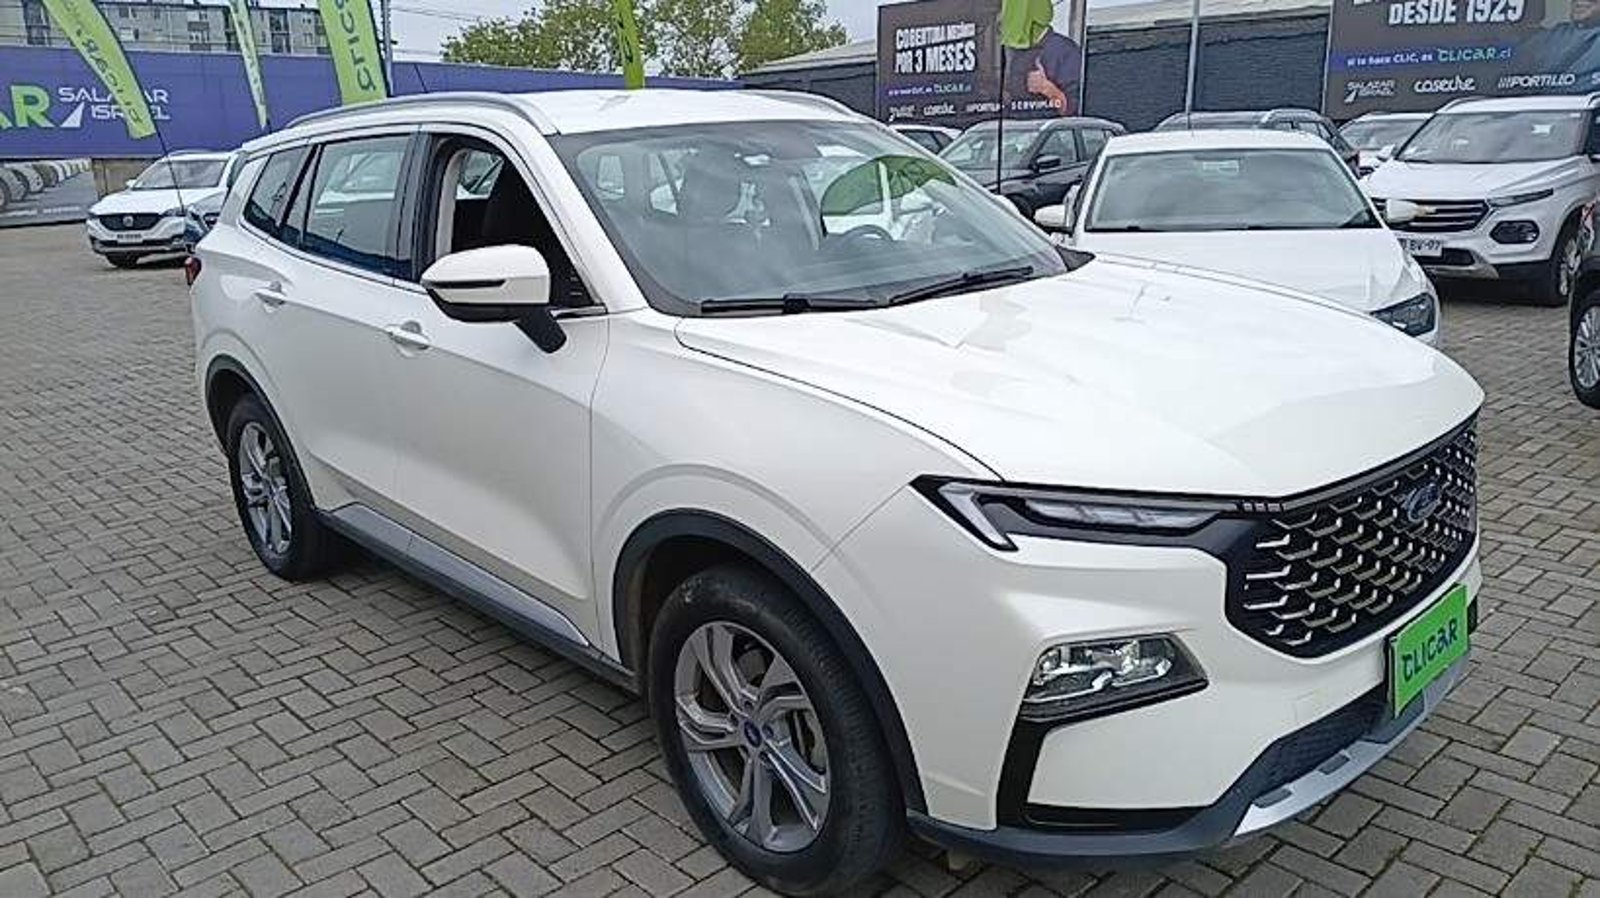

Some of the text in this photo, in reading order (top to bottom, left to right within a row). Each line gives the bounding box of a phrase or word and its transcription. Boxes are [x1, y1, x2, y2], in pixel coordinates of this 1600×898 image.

[1388, 0, 1524, 25] DESDE 1929
[915, 48, 923, 73] 3
[925, 40, 976, 72] MESES
[58, 86, 169, 103] SALAR
[91, 105, 171, 119] ISRL
